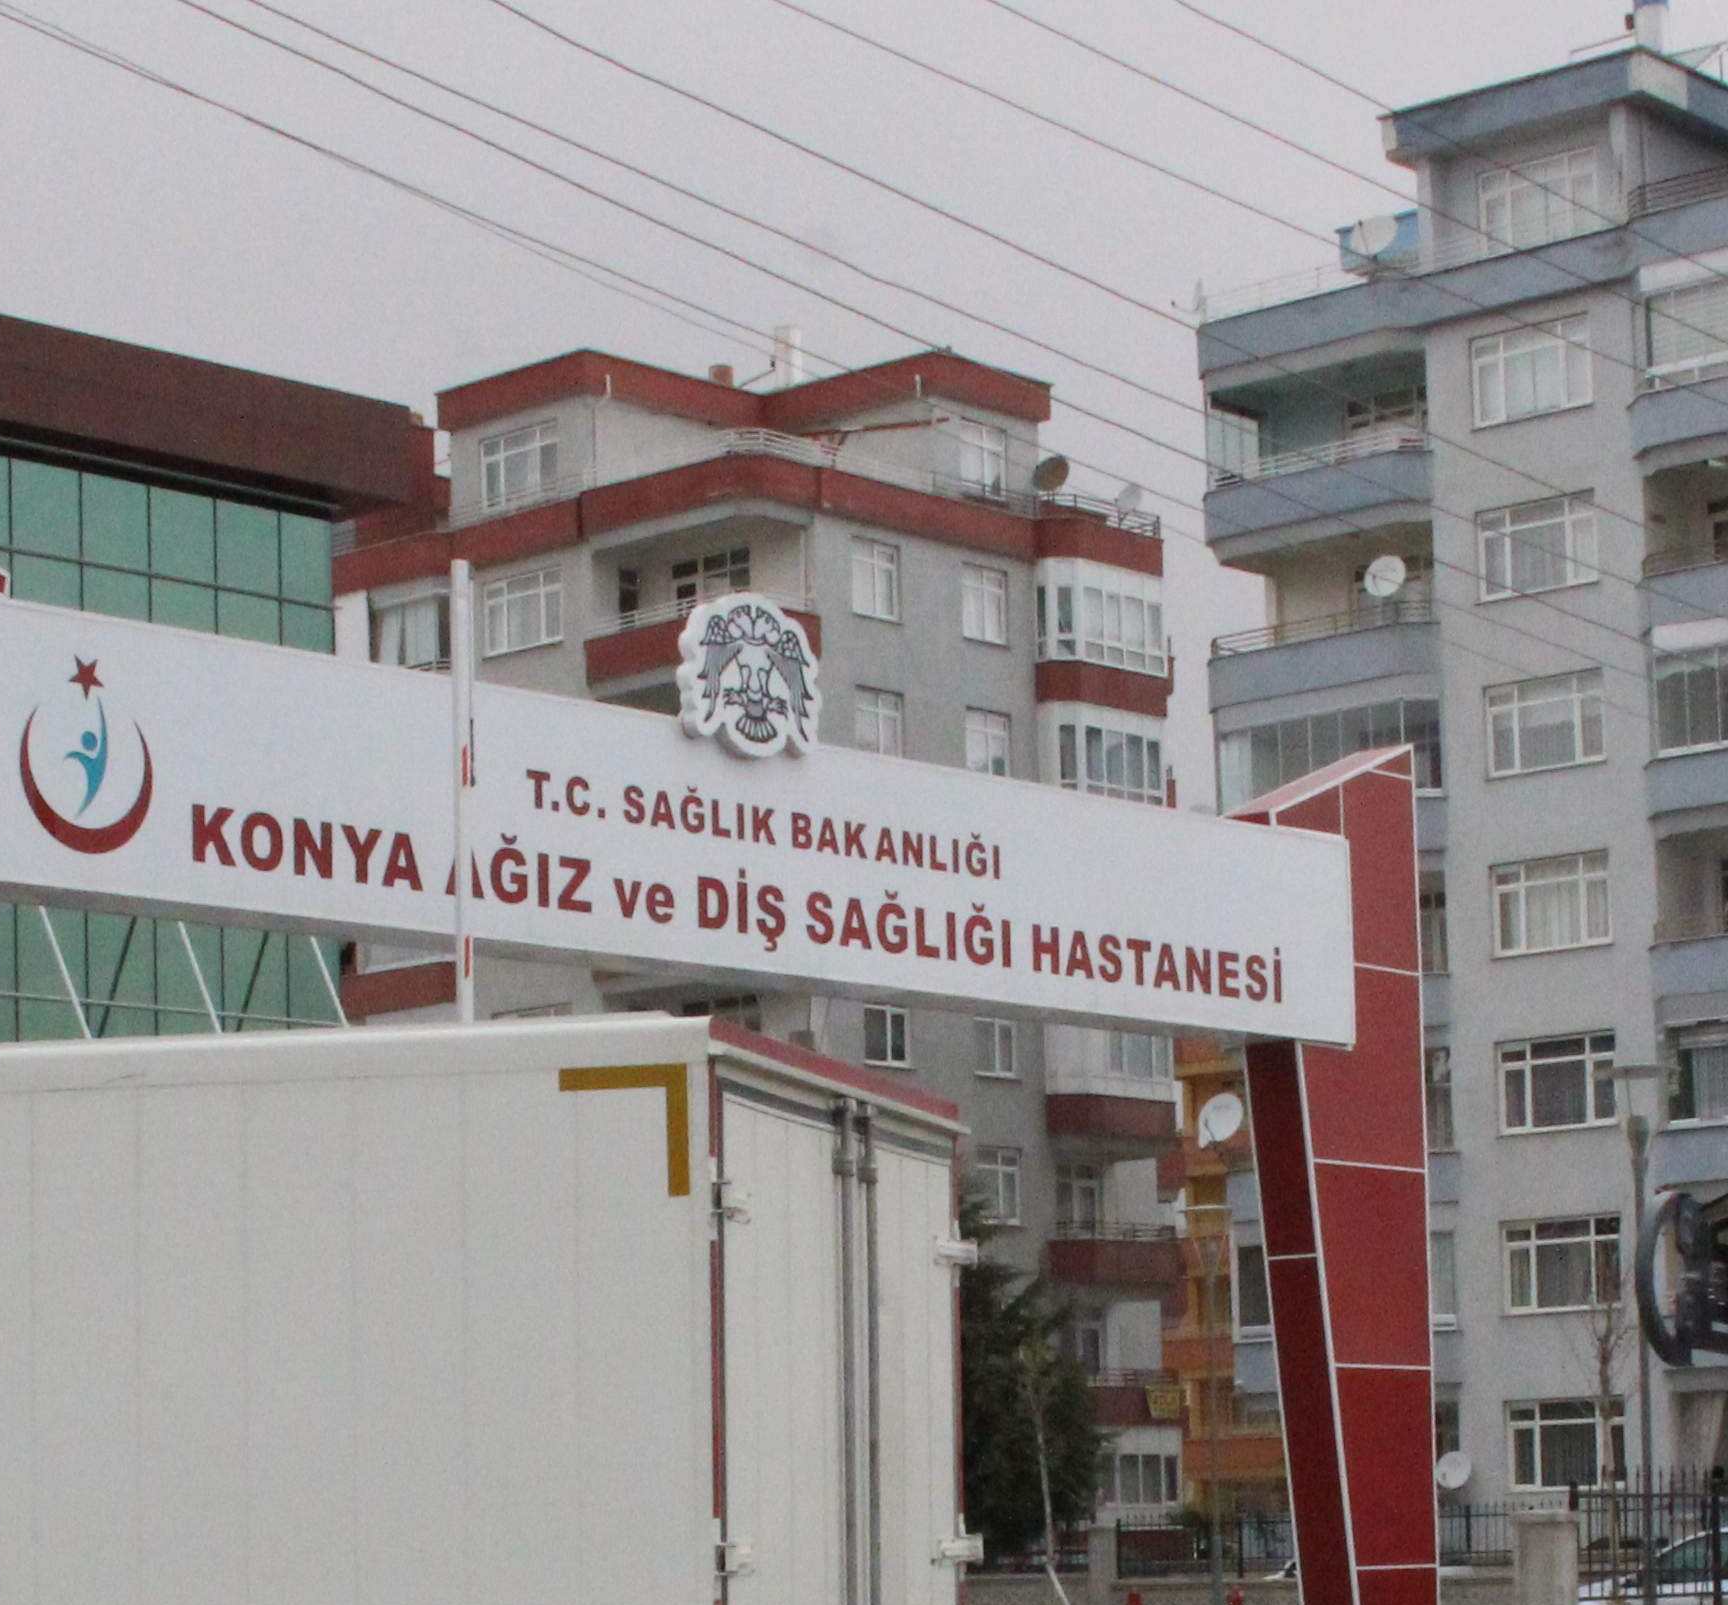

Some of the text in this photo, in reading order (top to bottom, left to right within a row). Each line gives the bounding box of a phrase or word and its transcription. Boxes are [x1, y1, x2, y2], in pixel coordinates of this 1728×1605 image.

[528, 772, 1000, 879] T.C. SAĞLIK BAKANLIĞI
[192, 805, 422, 891] KONYA
[614, 880, 675, 923] ve
[698, 877, 785, 950] DİŞ
[806, 892, 1011, 968] SAĞLIĞI
[1032, 924, 1281, 1002] HASTANESİ
